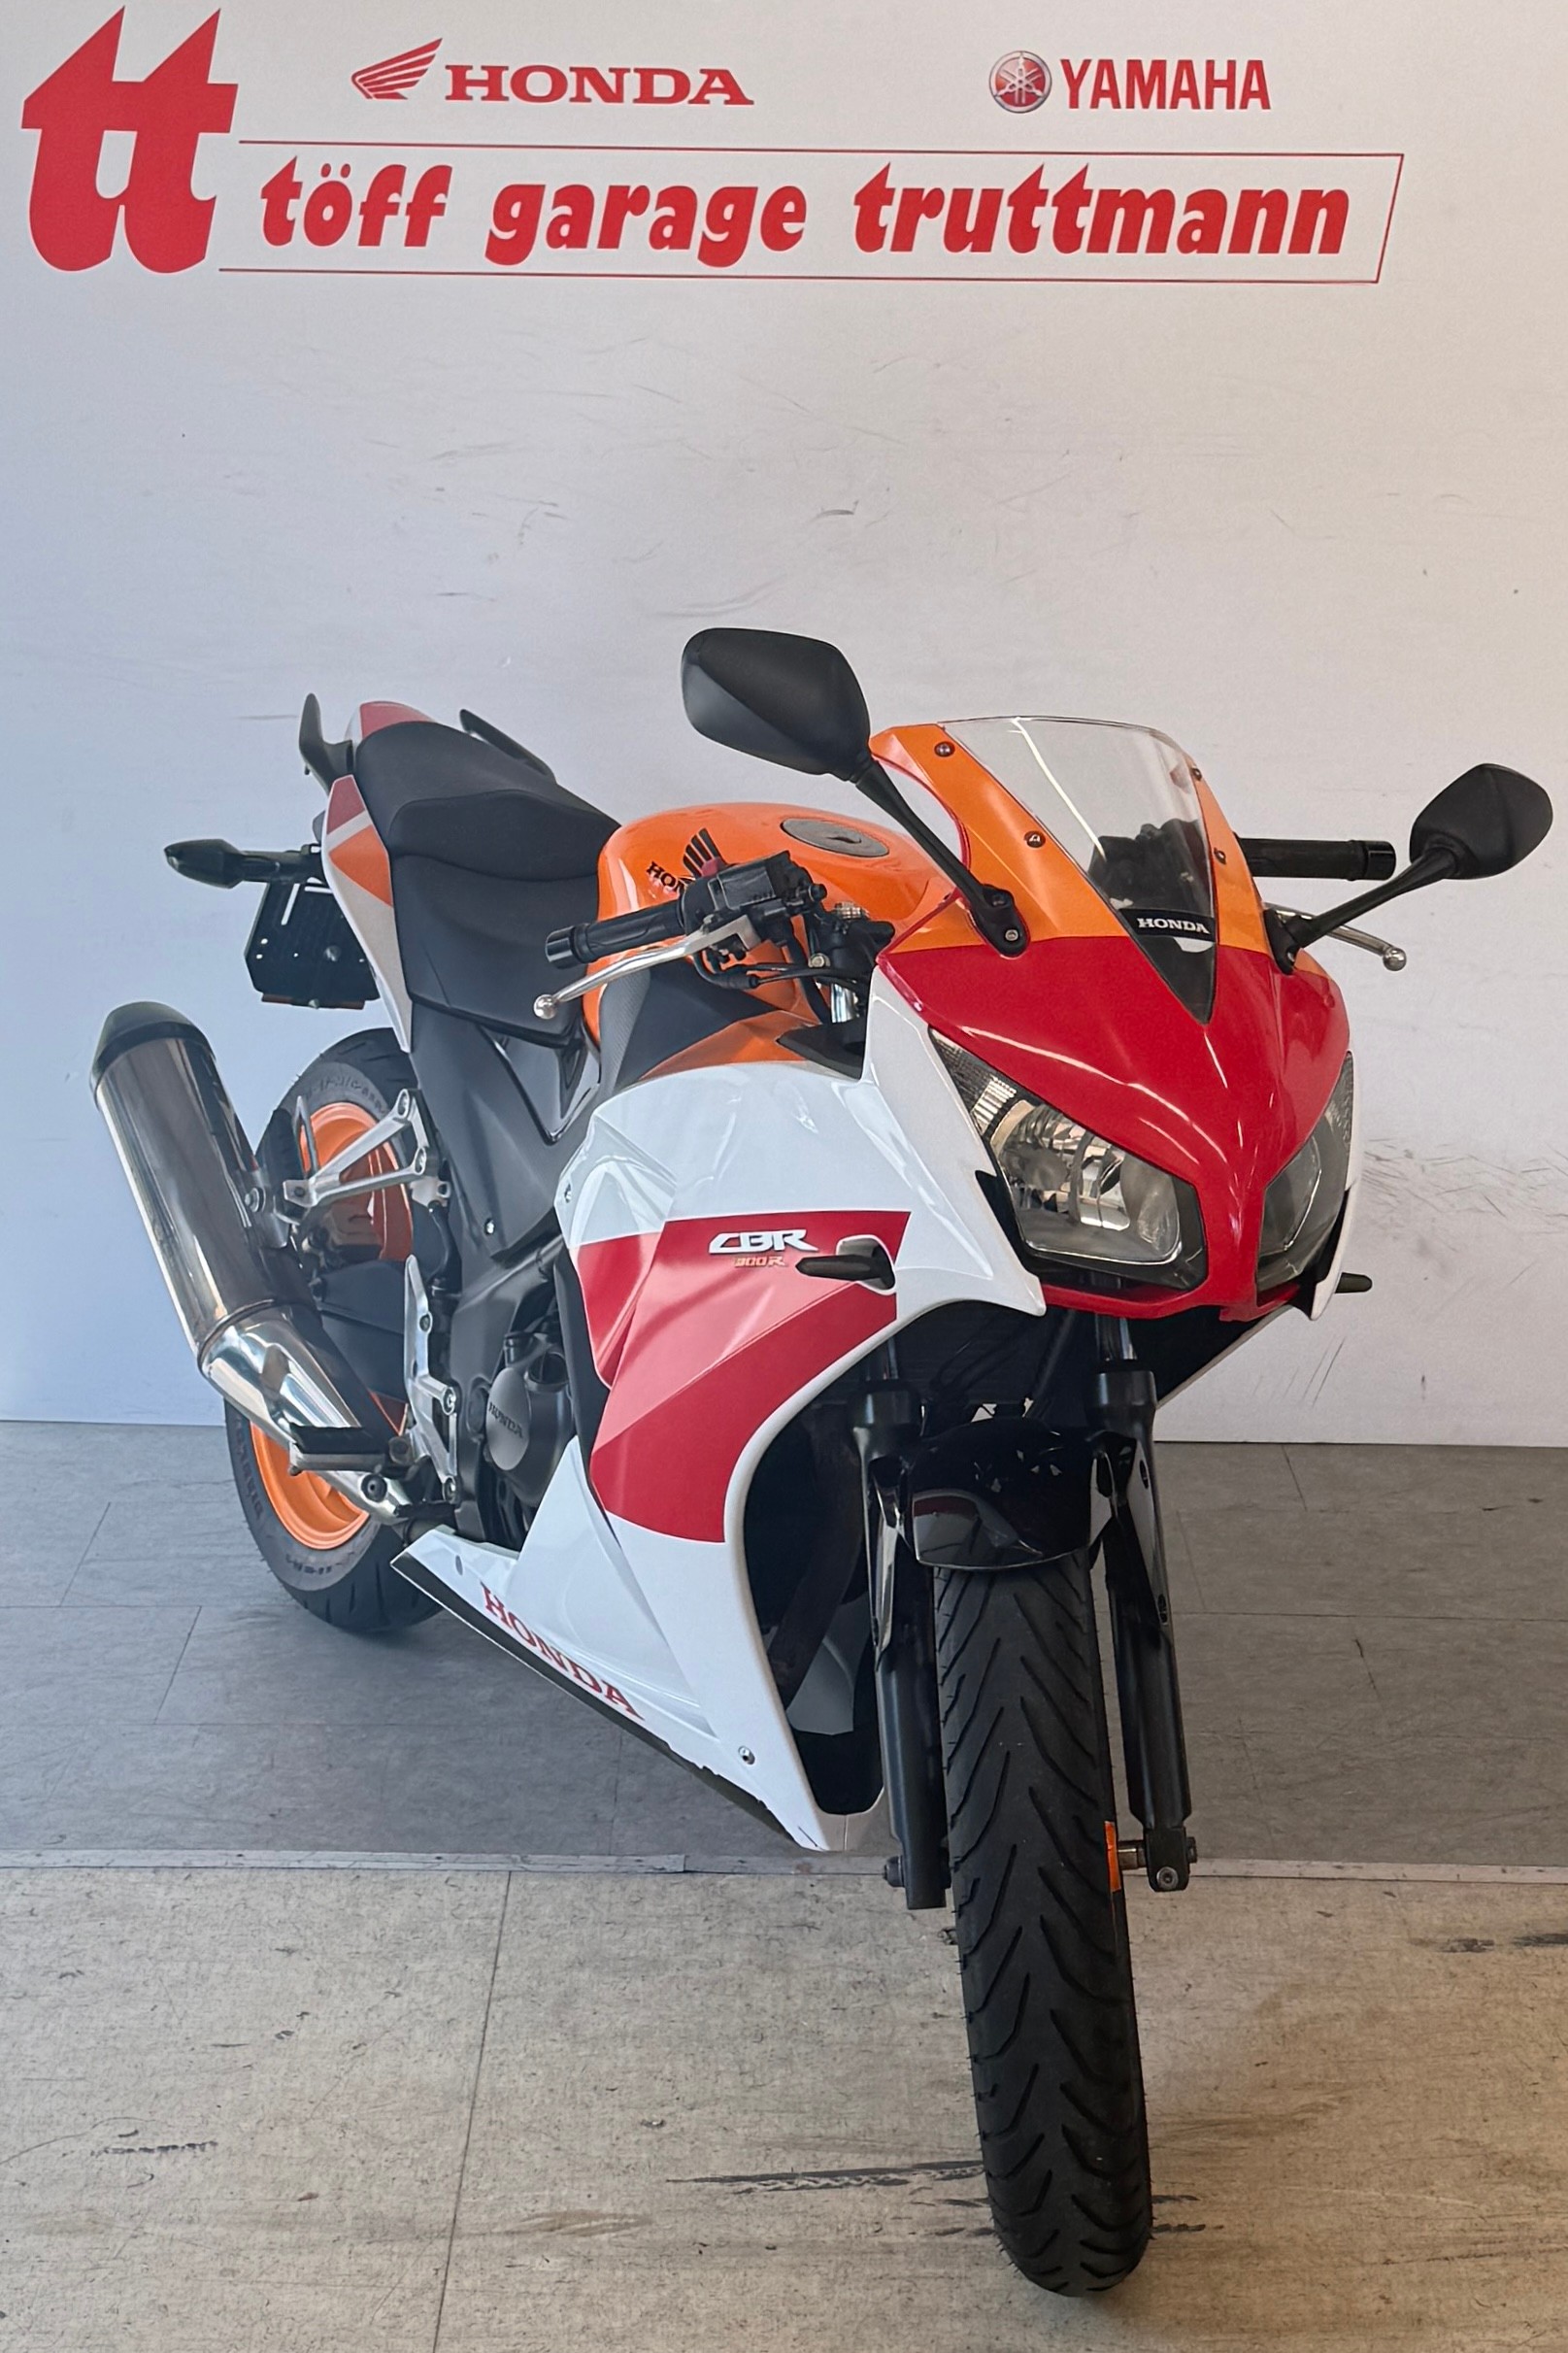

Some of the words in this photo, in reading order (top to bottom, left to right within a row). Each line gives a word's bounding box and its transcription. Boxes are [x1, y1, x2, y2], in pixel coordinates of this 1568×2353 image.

[446, 64, 754, 106] HONDA
[1060, 58, 1271, 111] YAMAHA
[260, 155, 452, 249] töff
[484, 181, 807, 268] garage
[853, 162, 1350, 254] truttmann
[1137, 918, 1211, 935] HONDA
[708, 1228, 819, 1255] CBR
[488, 1401, 524, 1438] HONDA
[480, 1580, 645, 1721] HONDA
